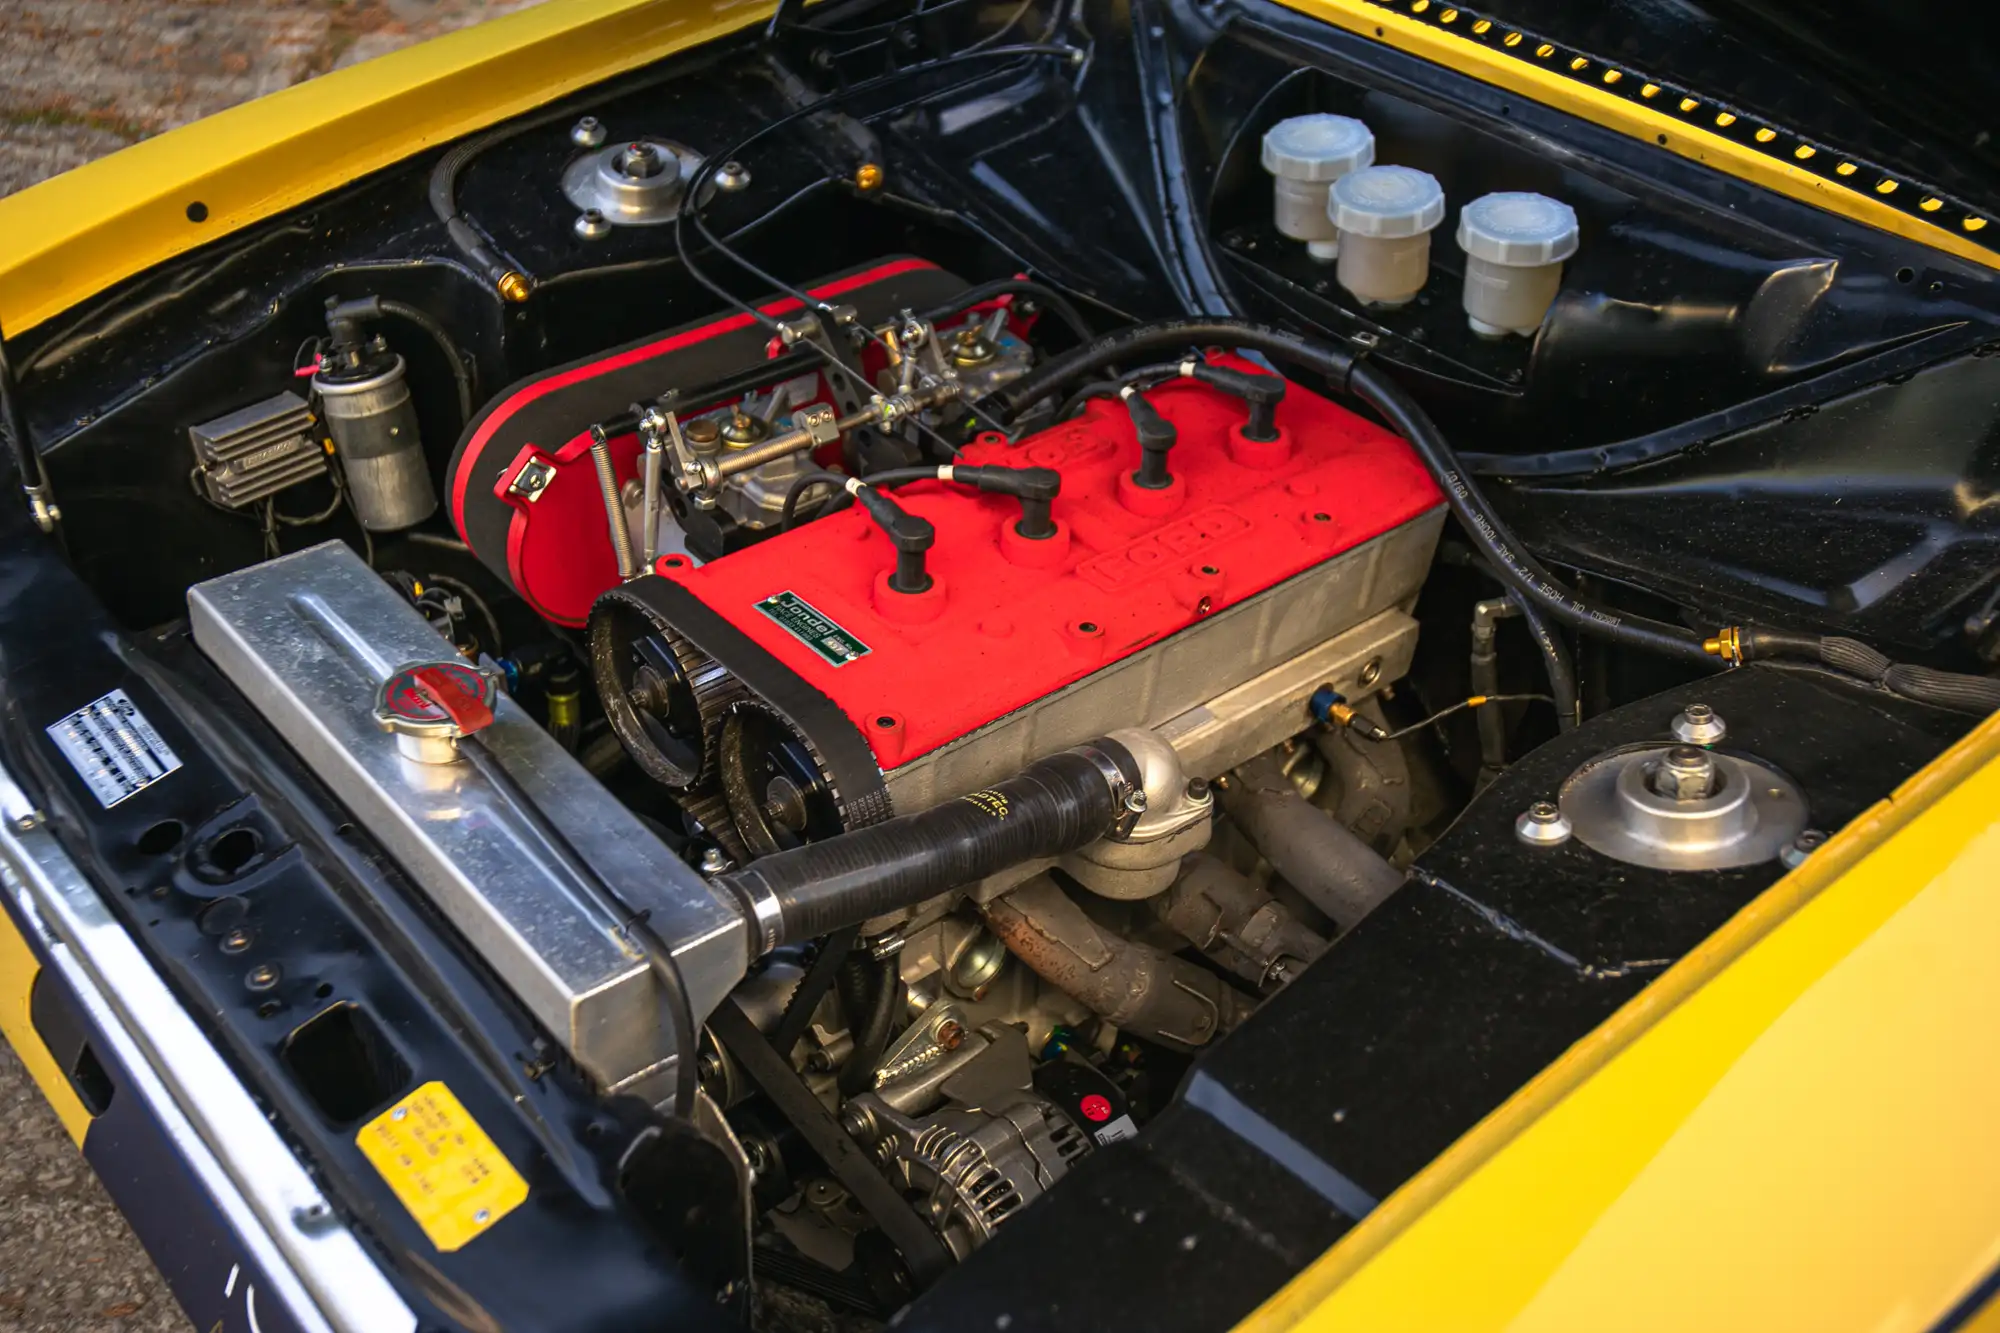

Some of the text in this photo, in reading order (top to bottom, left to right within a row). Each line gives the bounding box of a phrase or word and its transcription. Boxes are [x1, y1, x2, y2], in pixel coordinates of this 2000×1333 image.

[1090, 509, 1245, 583] FORD
[1499, 542, 1516, 565] SAE
[1514, 565, 1536, 584] 1/2"
[1538, 581, 1566, 603] HOSE
[780, 597, 838, 637] Jondel
[1571, 600, 1586, 614] OIL
[791, 616, 822, 638] ENGINES
